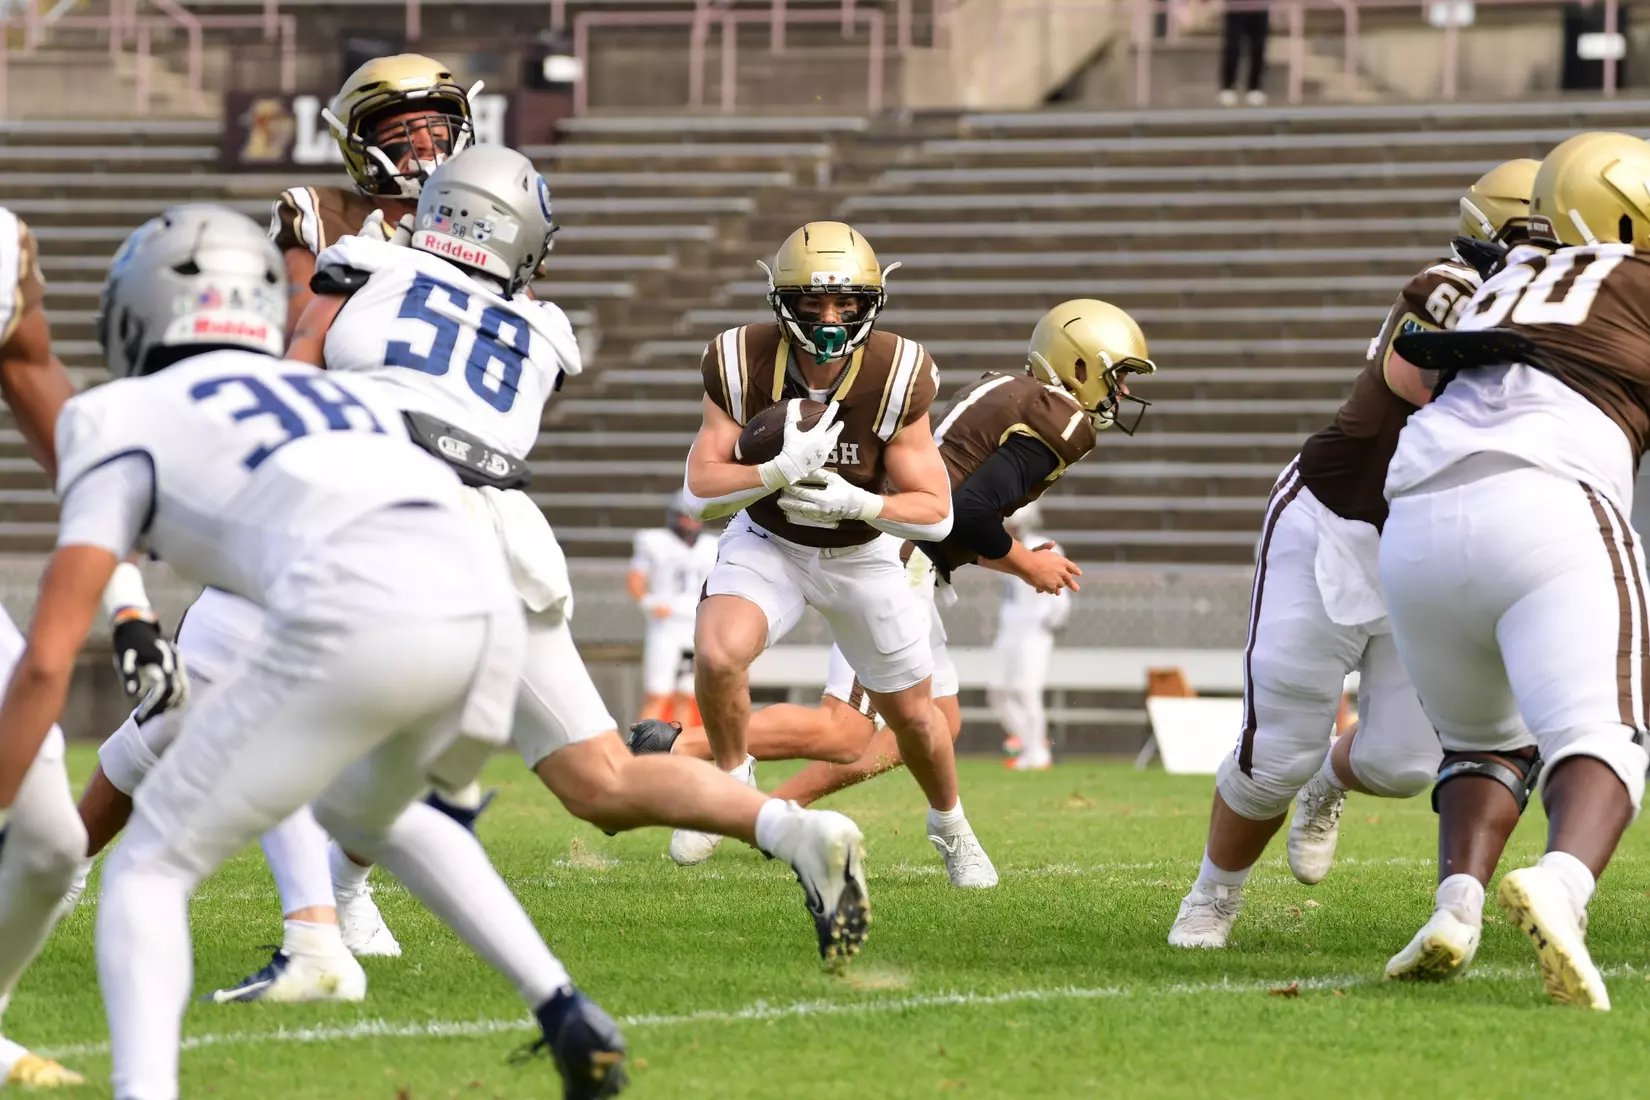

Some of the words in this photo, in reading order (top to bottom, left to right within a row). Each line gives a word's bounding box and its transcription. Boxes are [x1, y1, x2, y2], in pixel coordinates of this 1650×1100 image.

[425, 234, 488, 267] Riddell
[384, 270, 531, 414] 58
[189, 373, 388, 471] 38
